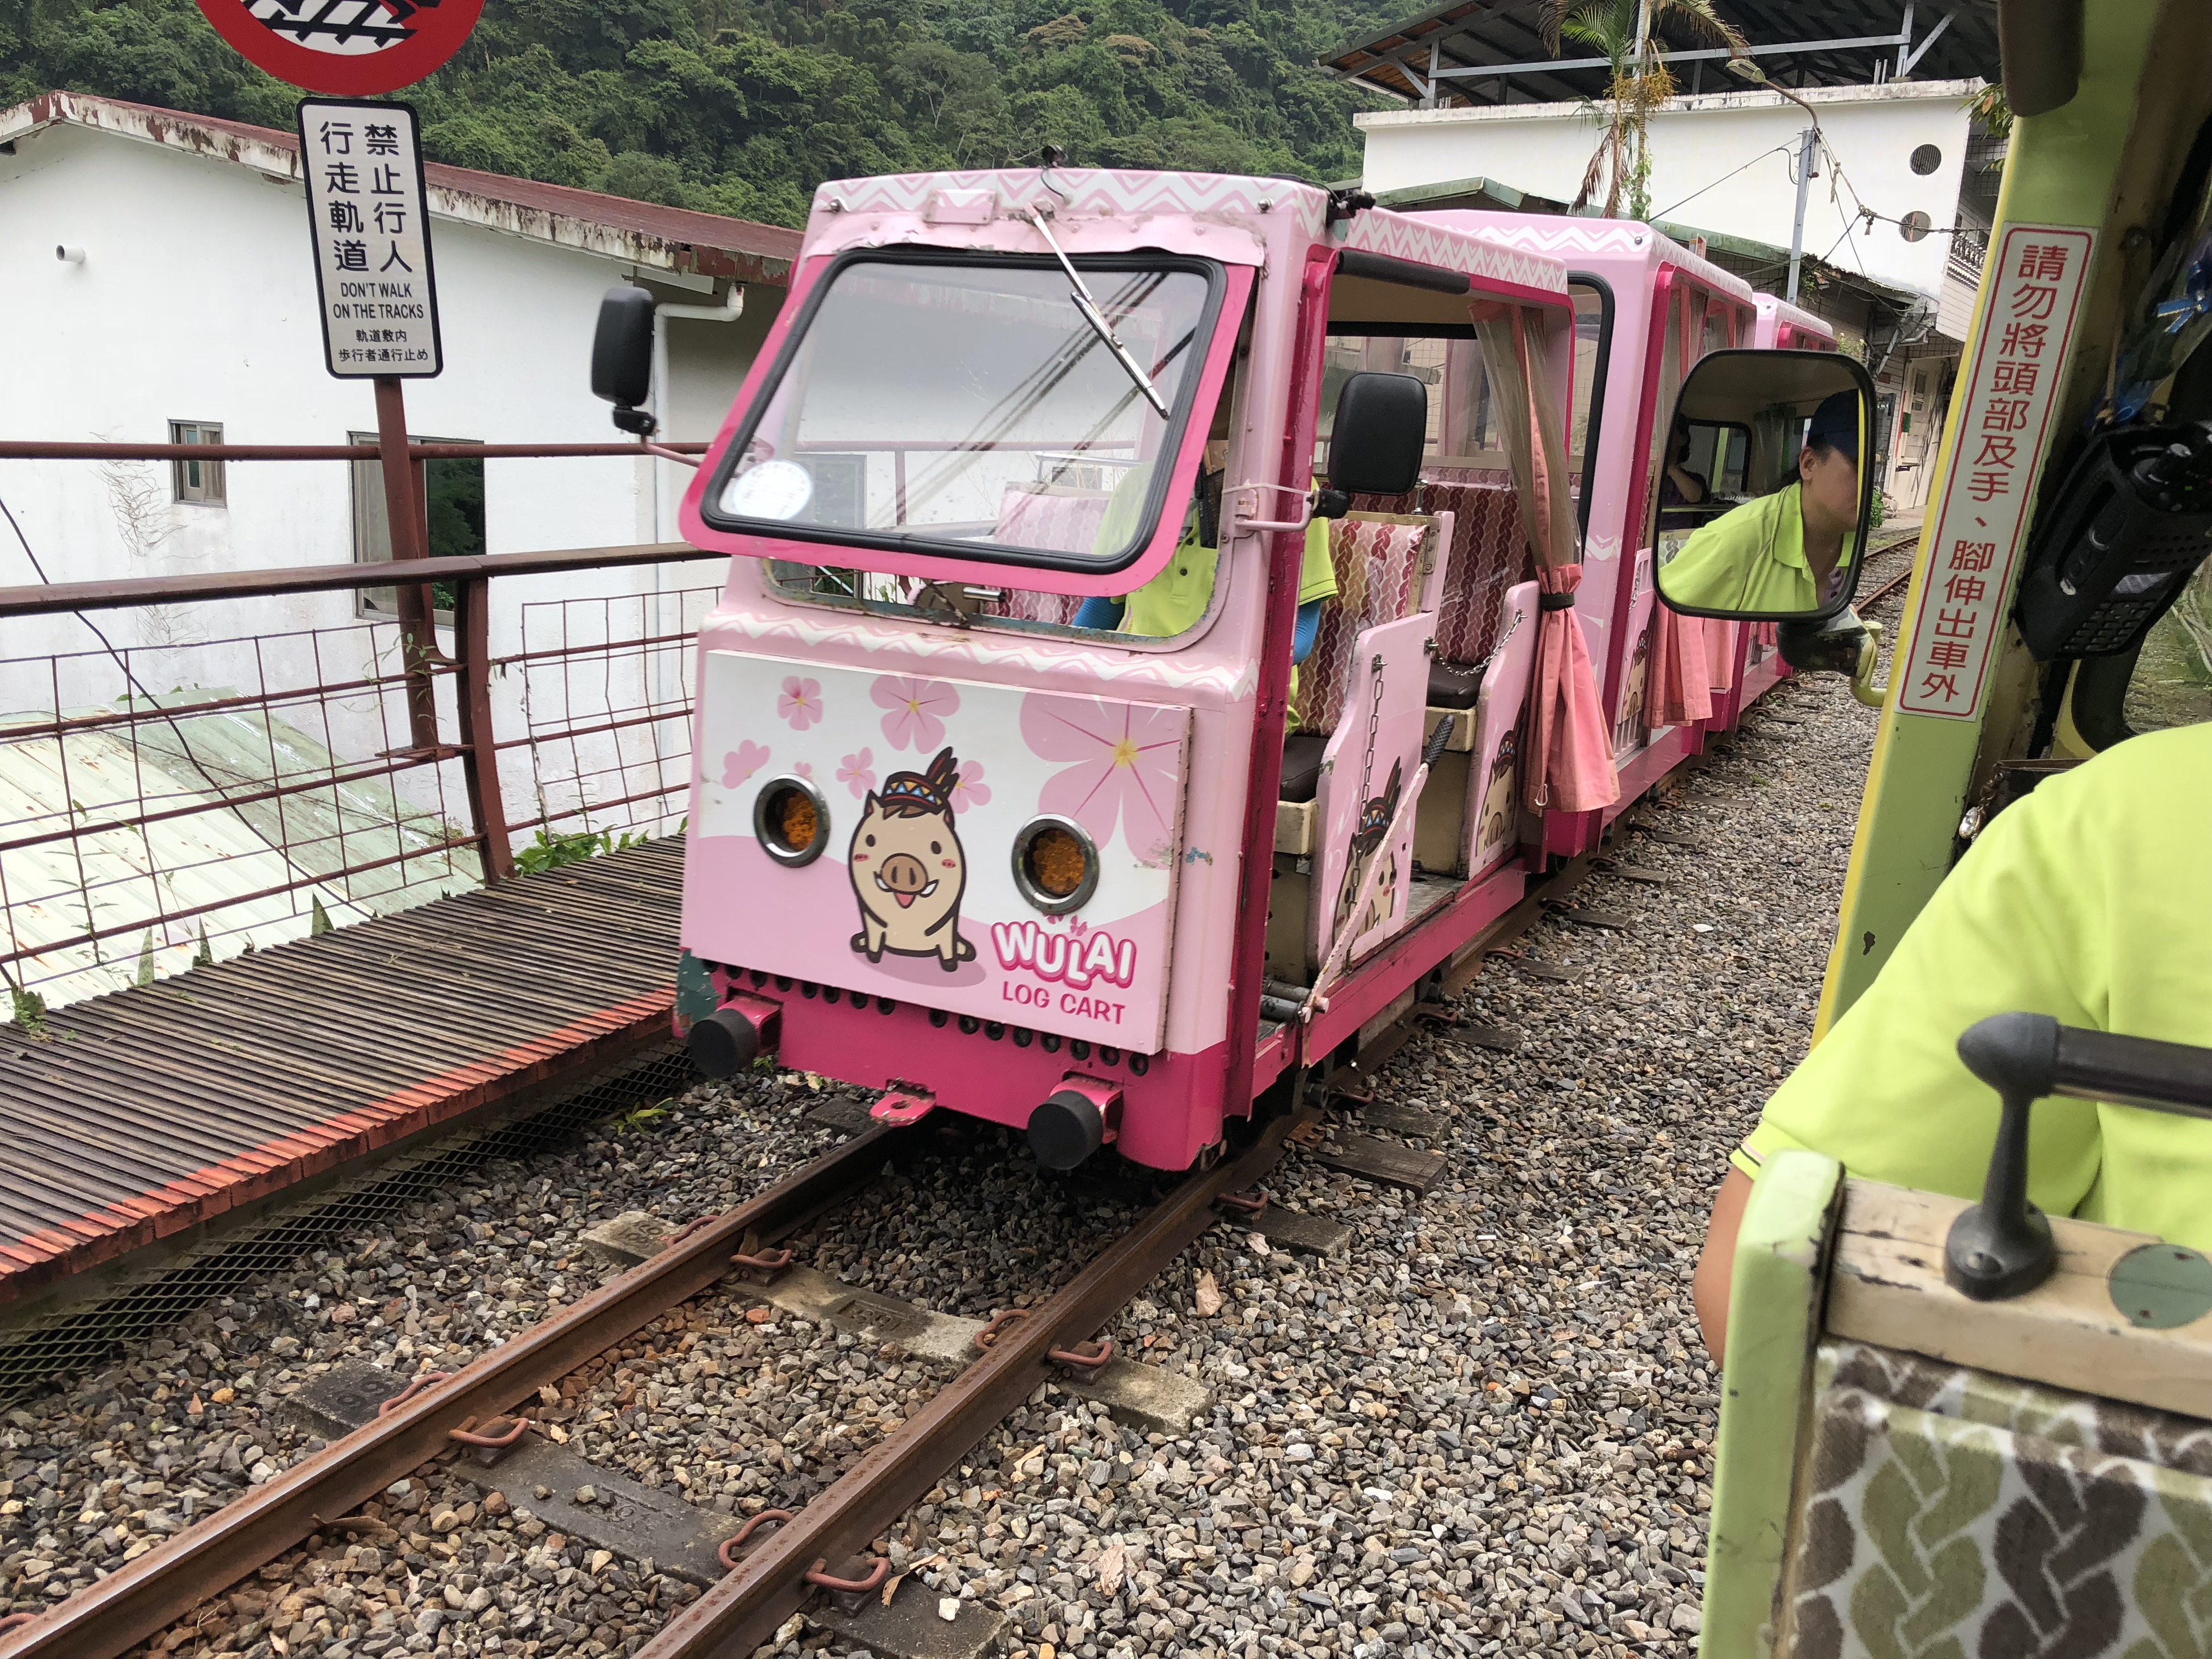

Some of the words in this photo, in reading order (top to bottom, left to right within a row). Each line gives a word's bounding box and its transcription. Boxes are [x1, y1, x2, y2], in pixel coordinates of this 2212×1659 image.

[320, 121, 369, 272] 行走軌道
[364, 123, 413, 273] 禁止行人
[333, 303, 350, 319] ON
[353, 303, 376, 319] THE
[378, 303, 424, 319] TRACKS
[340, 282, 375, 297] DON'T
[379, 283, 412, 298] WALK
[338, 348, 428, 362] 歩行者通行止め
[991, 921, 1137, 991] WULAI
[1002, 980, 1050, 1008] LOG
[1059, 994, 1126, 1025] CART
